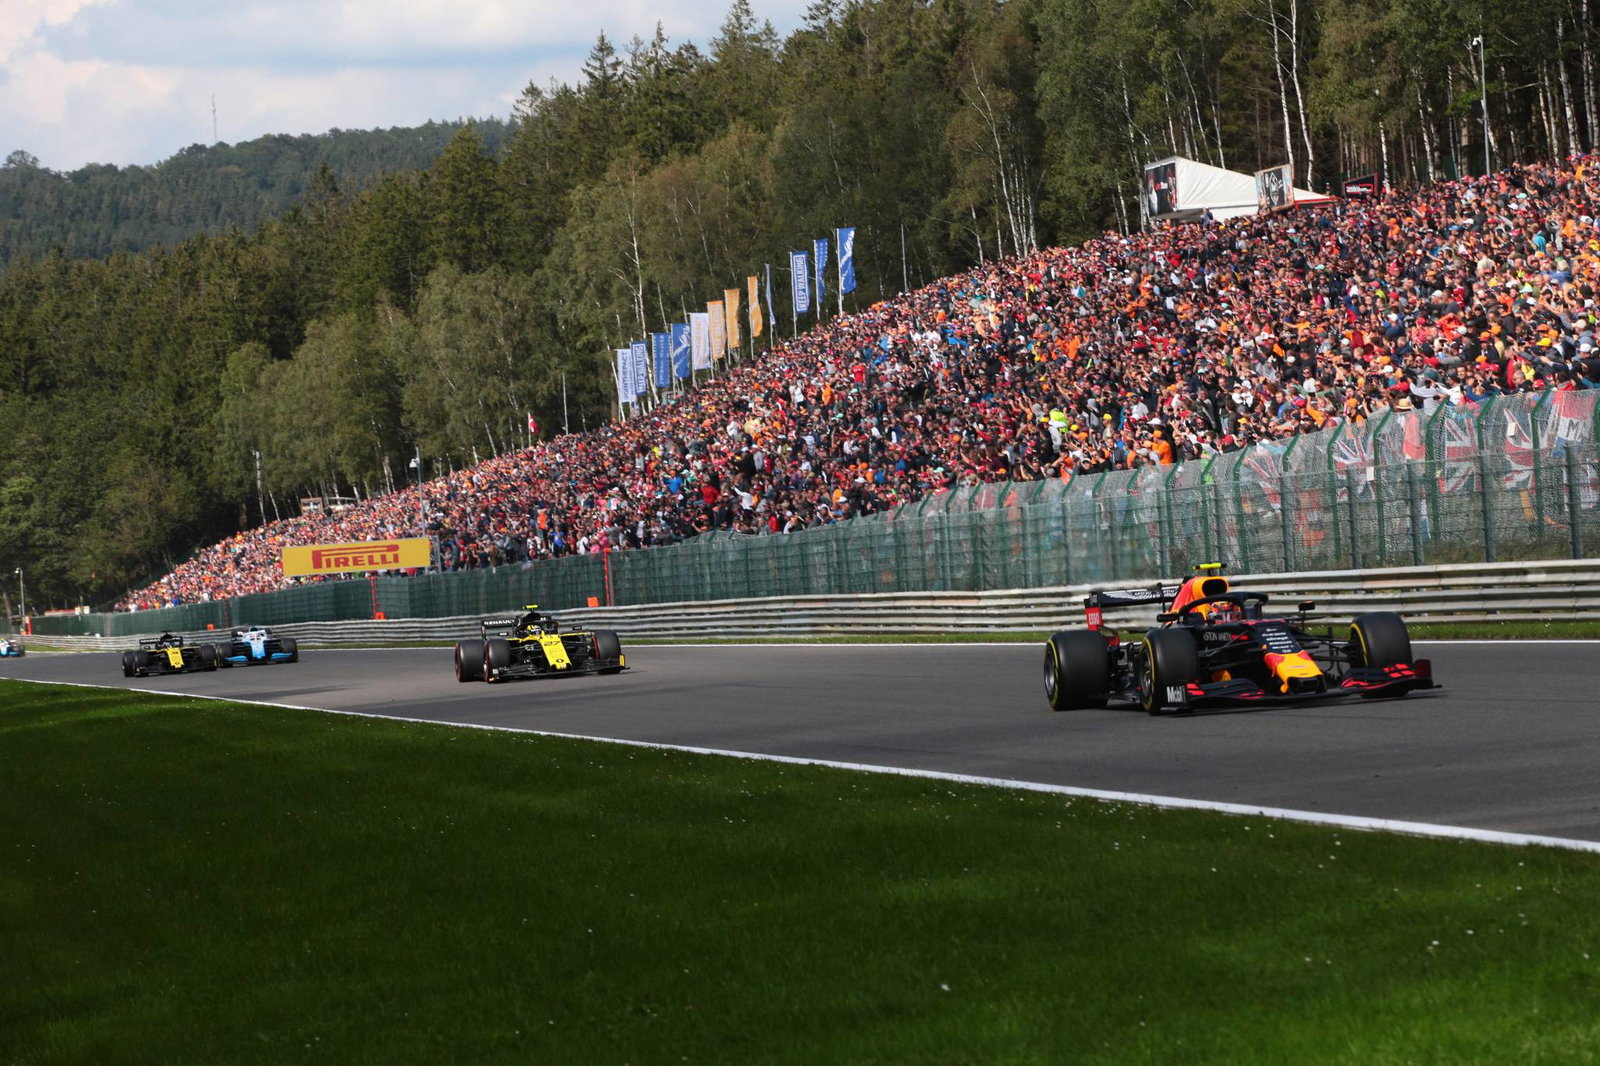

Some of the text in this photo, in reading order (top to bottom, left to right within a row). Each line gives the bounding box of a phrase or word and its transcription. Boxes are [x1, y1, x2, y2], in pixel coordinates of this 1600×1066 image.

[795, 256, 807, 309] KEEP WALKING
[312, 544, 400, 569] PIRELLI
